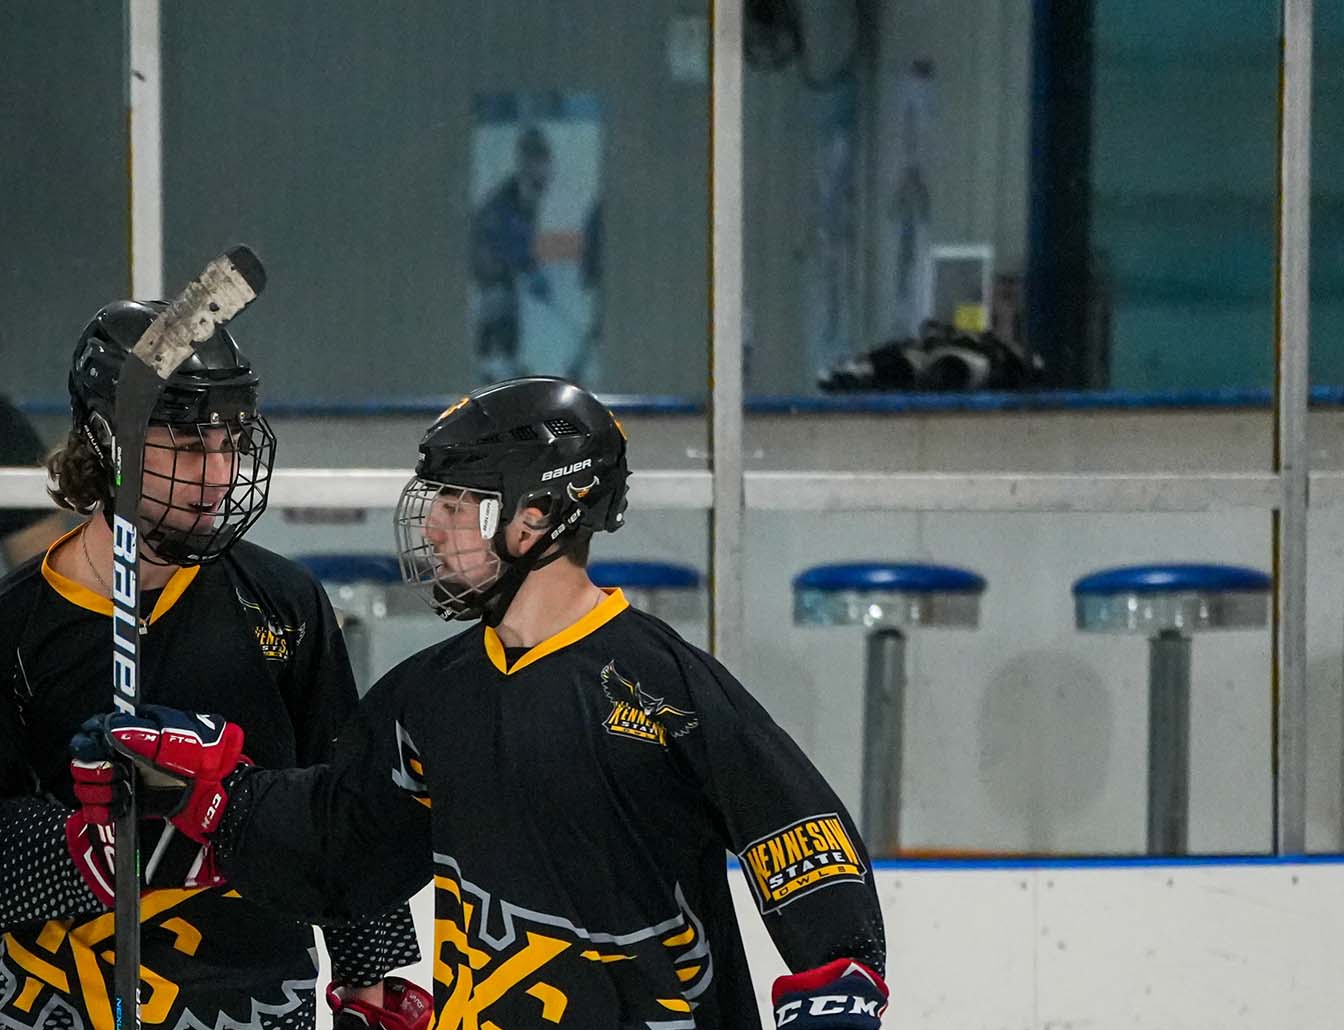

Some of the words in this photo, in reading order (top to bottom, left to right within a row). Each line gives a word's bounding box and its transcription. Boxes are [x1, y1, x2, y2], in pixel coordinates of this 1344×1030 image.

[541, 458, 592, 481] BAUER
[746, 818, 860, 903] KENNESAW
[768, 850, 847, 890] STATE
[778, 865, 847, 897] OWLS
[776, 995, 879, 1028] CCM
